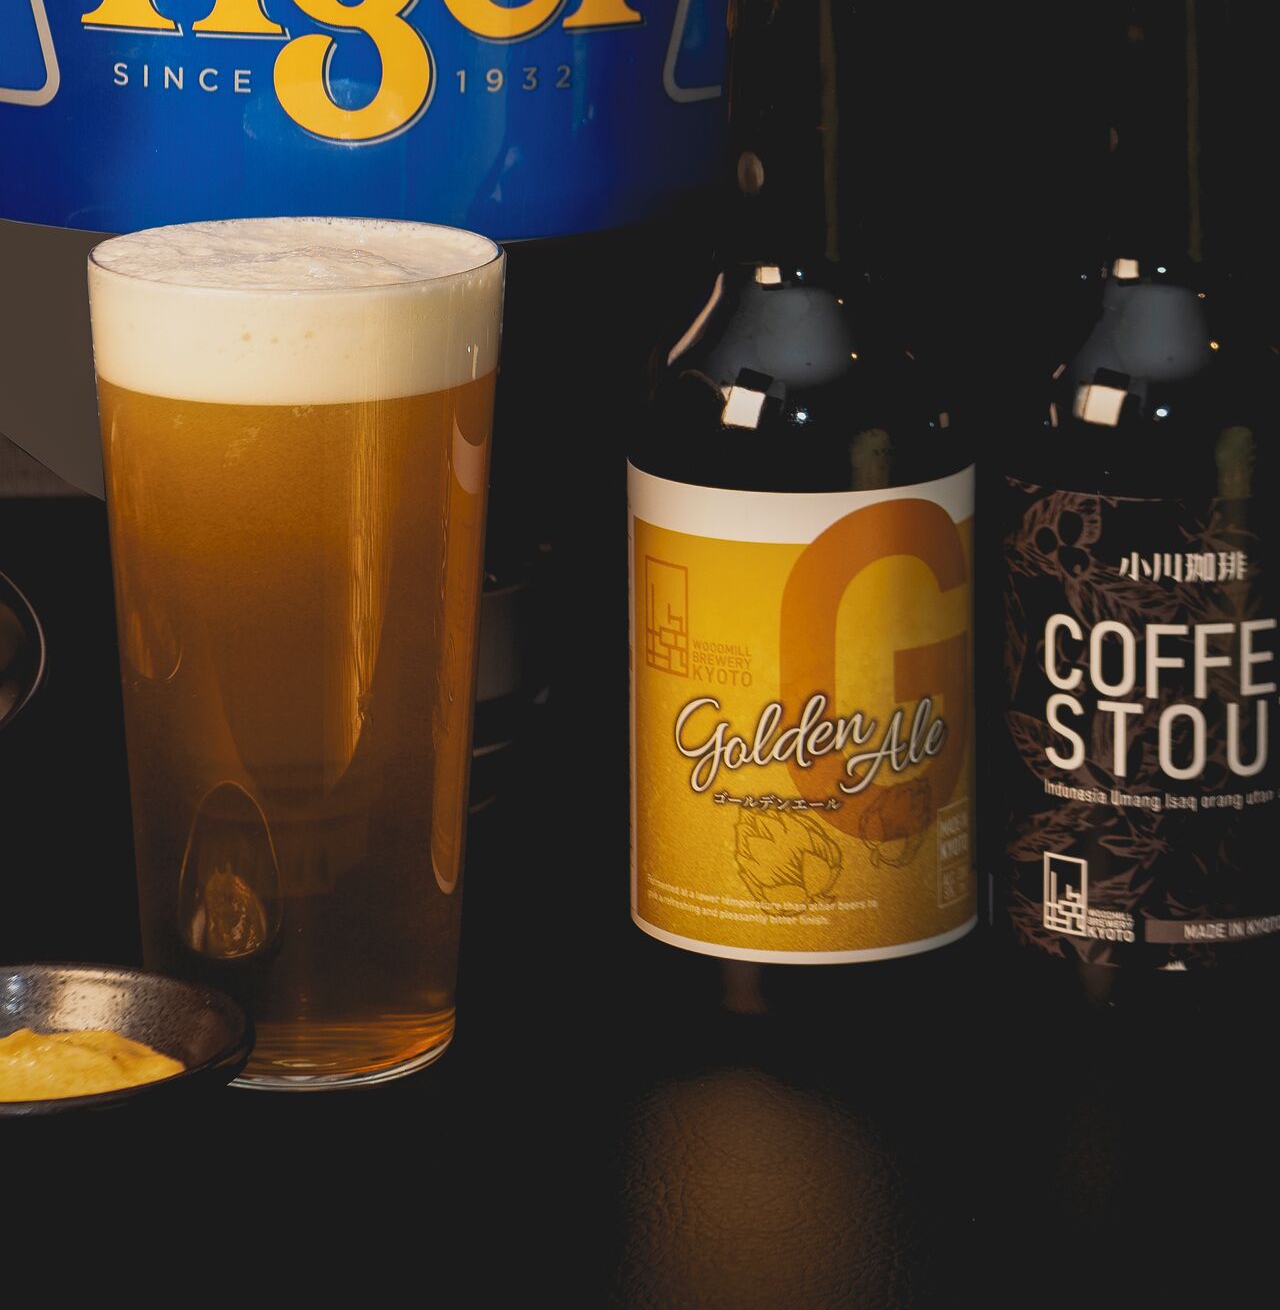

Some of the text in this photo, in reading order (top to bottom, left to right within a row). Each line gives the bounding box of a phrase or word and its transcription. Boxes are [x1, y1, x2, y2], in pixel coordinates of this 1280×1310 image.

[113, 63, 251, 94] SINCE
[456, 65, 571, 94] 1932
[1119, 551, 1248, 584] 小川珈琲
[692, 639, 752, 657] WOODMILL
[693, 651, 753, 671] BREWERY
[692, 664, 753, 688] KYOTO
[673, 694, 948, 794] Golden Ale
[713, 790, 842, 811] ゴールデンエール
[1044, 777, 1108, 805] Indonesia
[1110, 789, 1161, 812] Umang
[1164, 792, 1198, 812] Isaq
[1200, 793, 1244, 810] orang
[1087, 925, 1135, 943] KYOTO
[1183, 923, 1227, 940] MADE
[1228, 921, 1245, 938] IN
